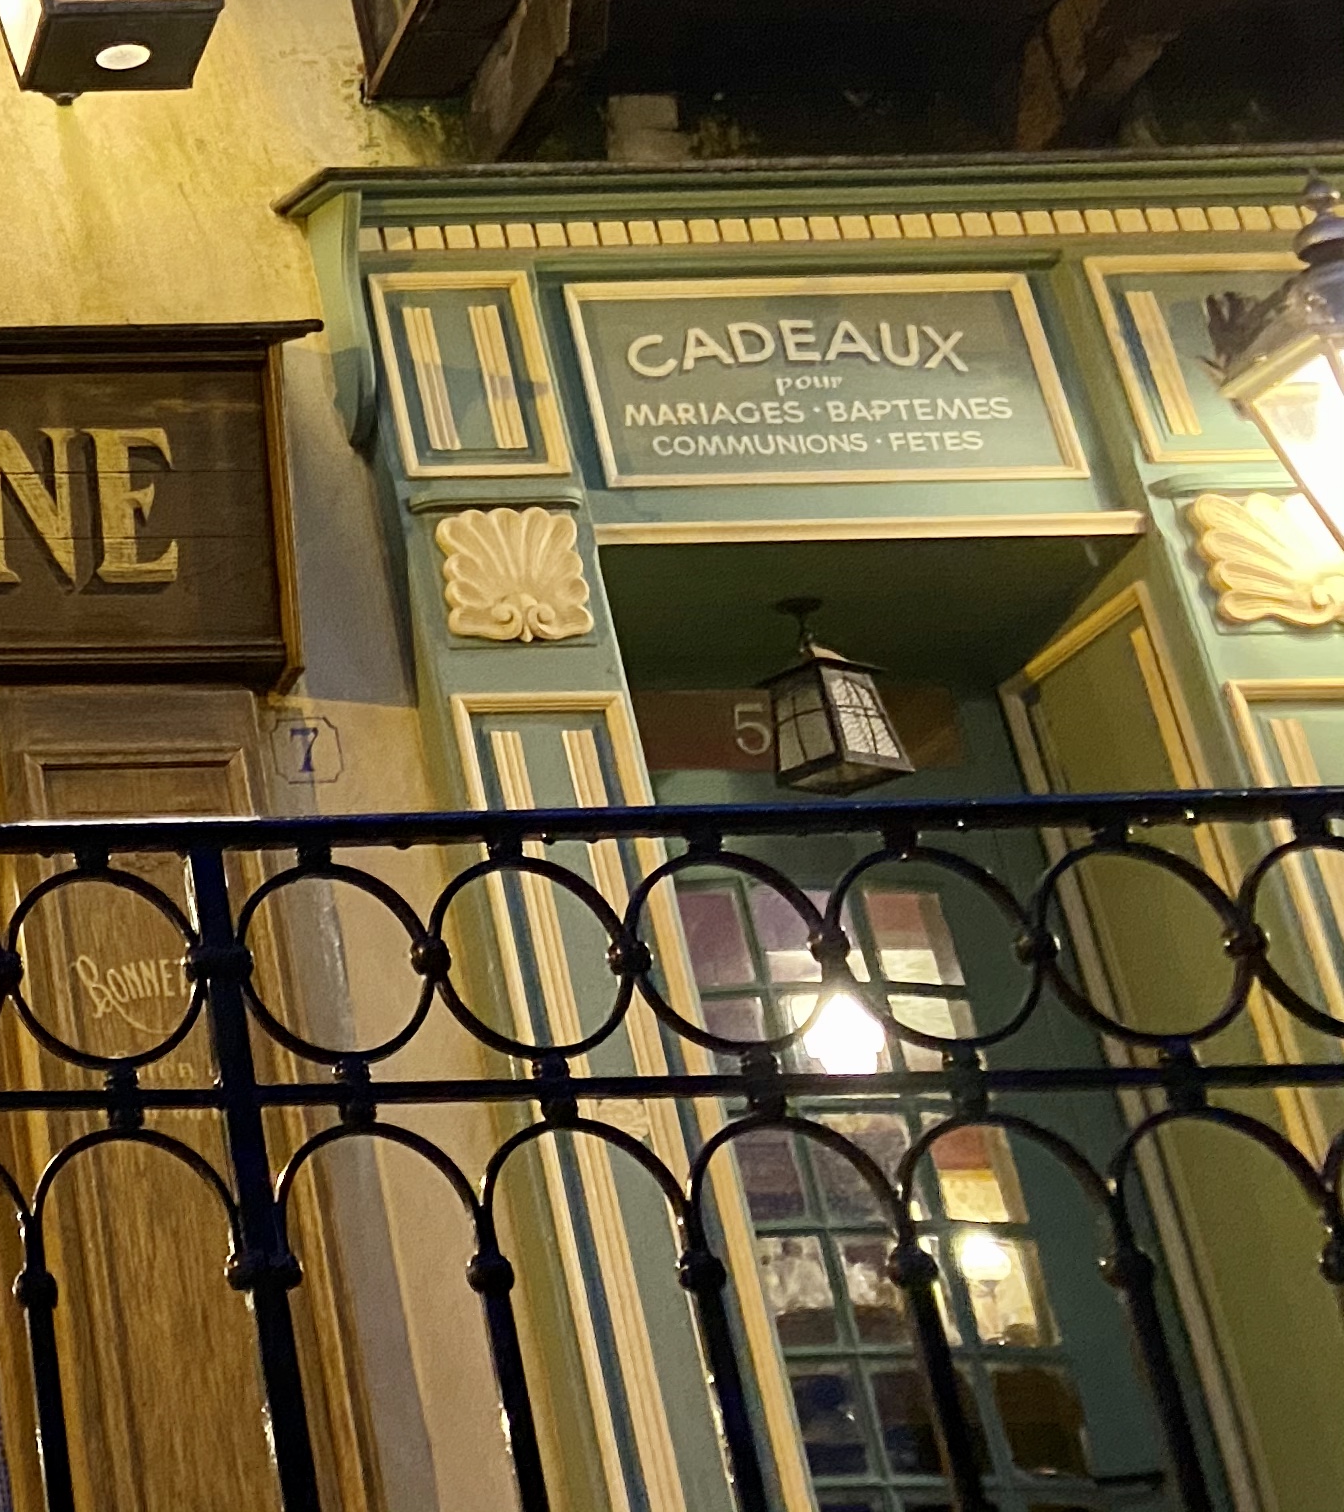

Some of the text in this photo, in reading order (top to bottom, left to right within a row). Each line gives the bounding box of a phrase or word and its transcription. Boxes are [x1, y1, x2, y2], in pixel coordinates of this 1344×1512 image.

[627, 319, 970, 378] CADEAUX
[775, 375, 844, 396] pour
[624, 397, 1014, 428] MARIAGES BAPTEMES
[651, 430, 984, 456] COMMUNIONS FETES
[734, 702, 772, 755] 5
[289, 727, 319, 774] 7
